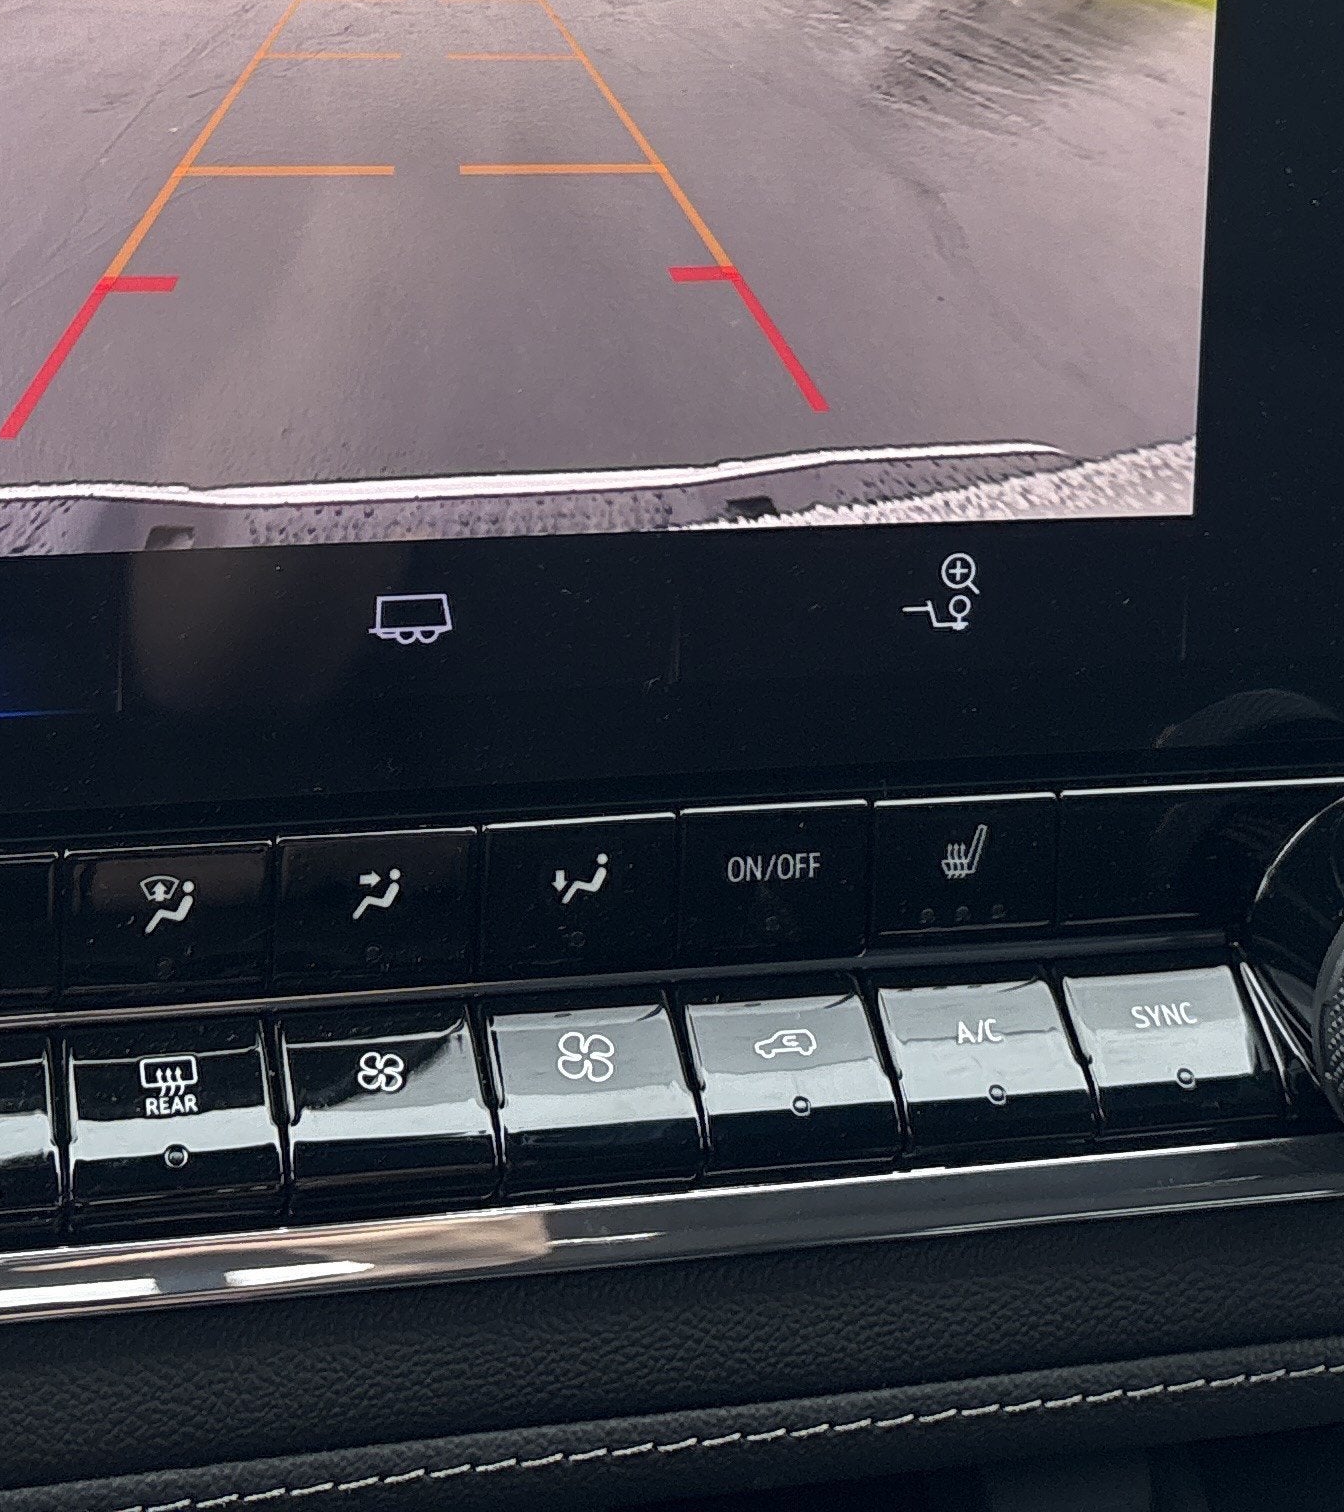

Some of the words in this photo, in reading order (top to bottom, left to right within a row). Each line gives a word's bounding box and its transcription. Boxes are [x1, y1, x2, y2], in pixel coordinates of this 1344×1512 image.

[727, 853, 821, 882] ON/OFF
[1131, 1002, 1198, 1029] SYNC
[957, 1018, 1002, 1044] A/C
[145, 1094, 198, 1116] REAR
